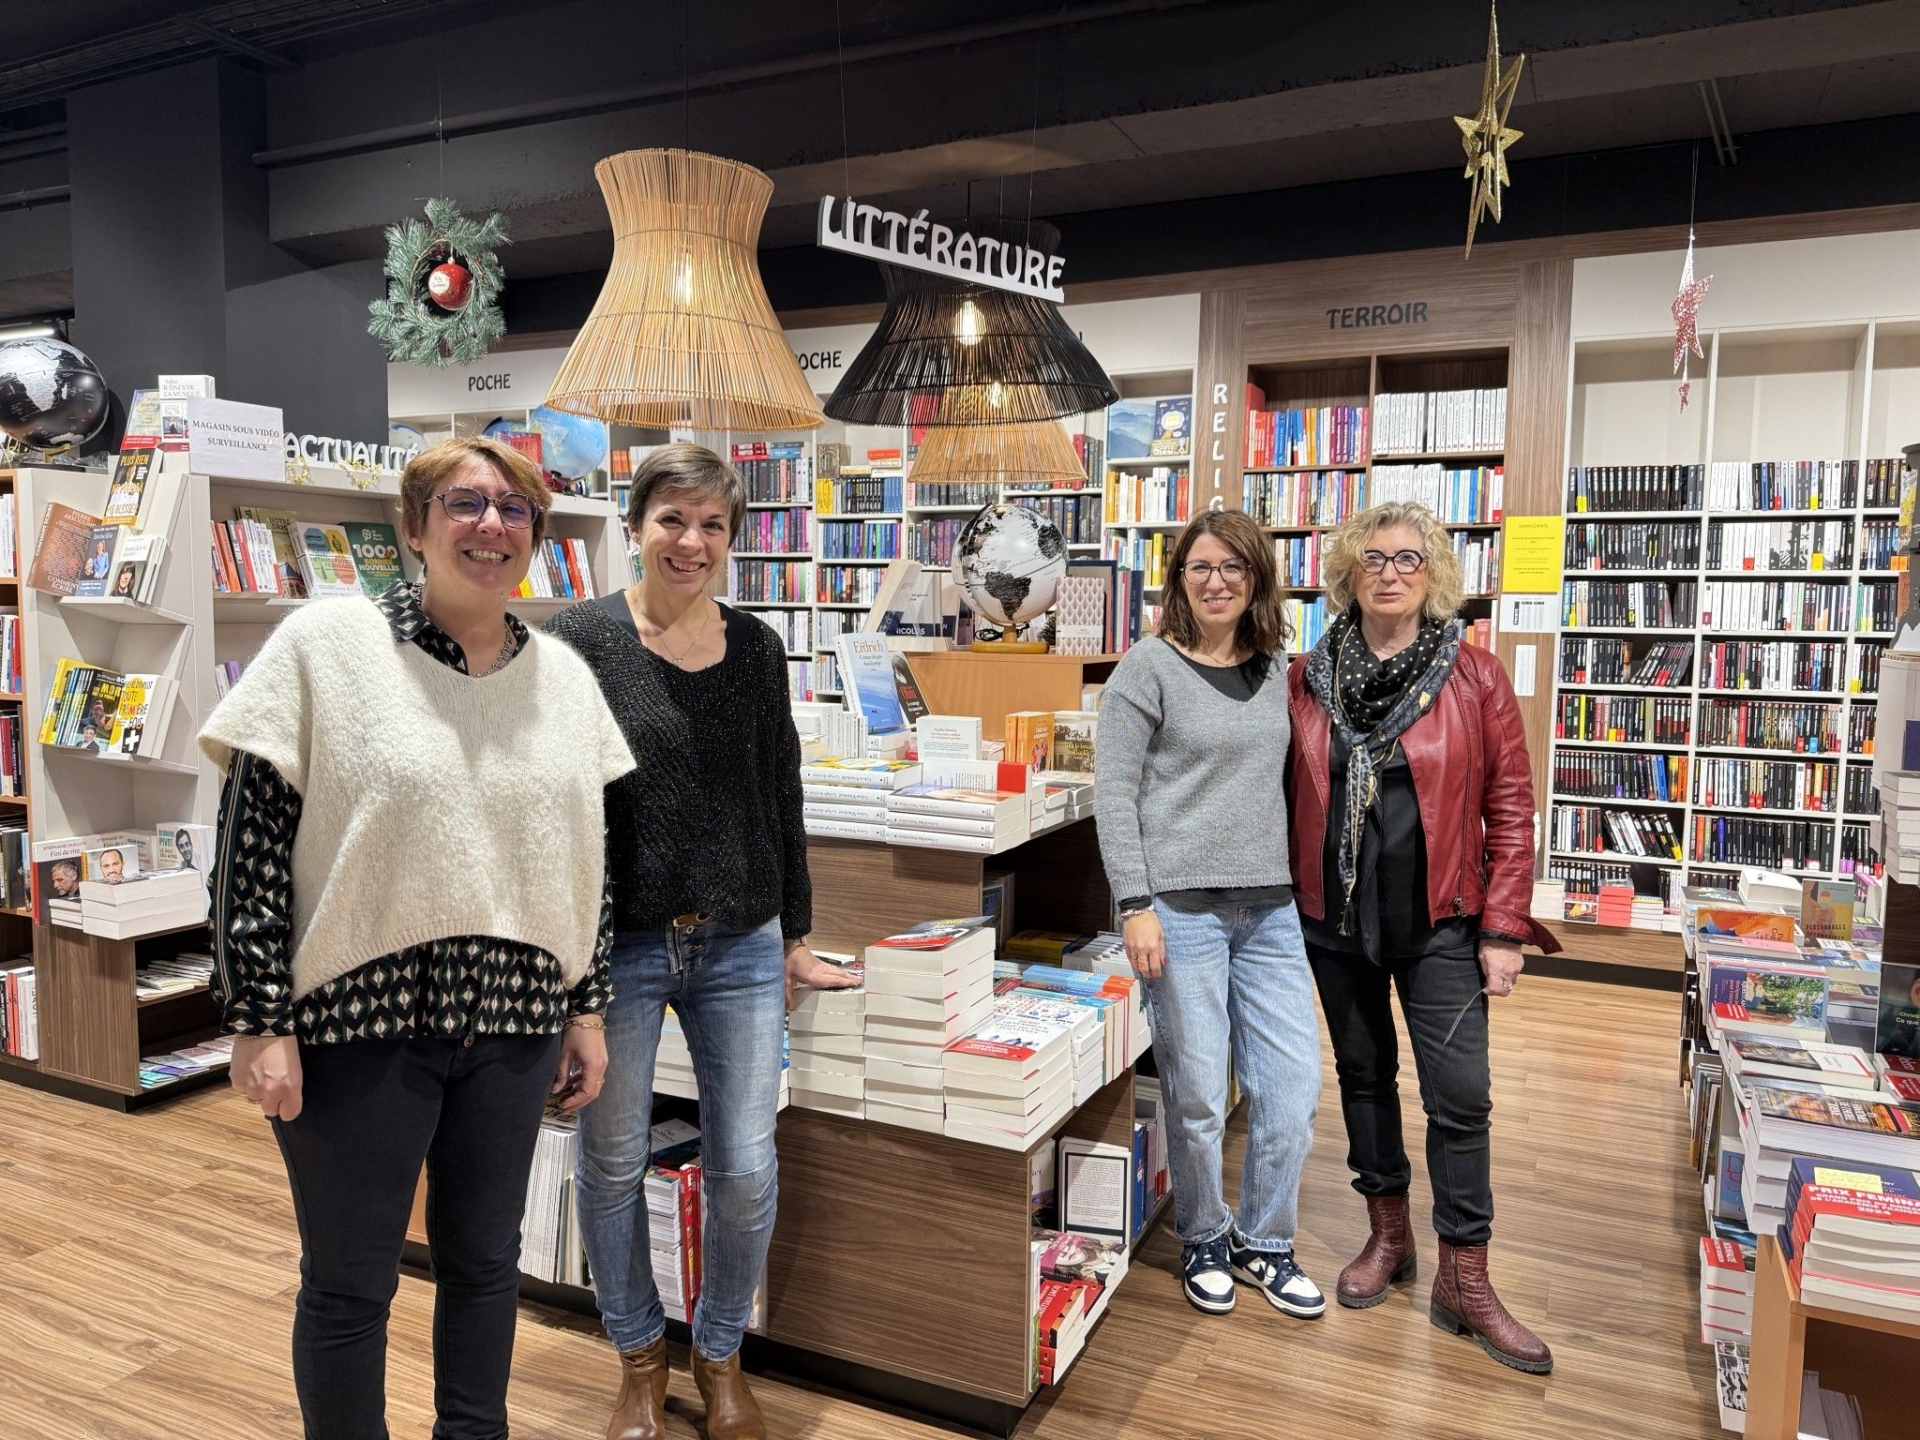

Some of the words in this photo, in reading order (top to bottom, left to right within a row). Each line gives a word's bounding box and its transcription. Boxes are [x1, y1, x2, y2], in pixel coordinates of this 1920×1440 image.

[818, 195, 1066, 292] LITTÉRATURE
[1326, 301, 1428, 330] TERROIR
[796, 350, 842, 371] OCHE
[468, 373, 511, 392] POCHE
[192, 420, 232, 432] MAGASIN
[233, 426, 254, 435] SOUS
[255, 428, 280, 438] VIDÉO
[208, 437, 268, 451] SURVEILLANCE
[1208, 383, 1228, 512] RELIG
[353, 544, 398, 559] 1000
[359, 564, 400, 572] NOUVELLES
[100, 683, 121, 697] MOR
[159, 837, 173, 847] PIVOT
[50, 850, 62, 858] Fini
[70, 848, 81, 856] rire
[1899, 1011, 1920, 1019] Christi
[1808, 1186, 1851, 1197] PRIX
[1856, 1206, 1892, 1215] 2024
